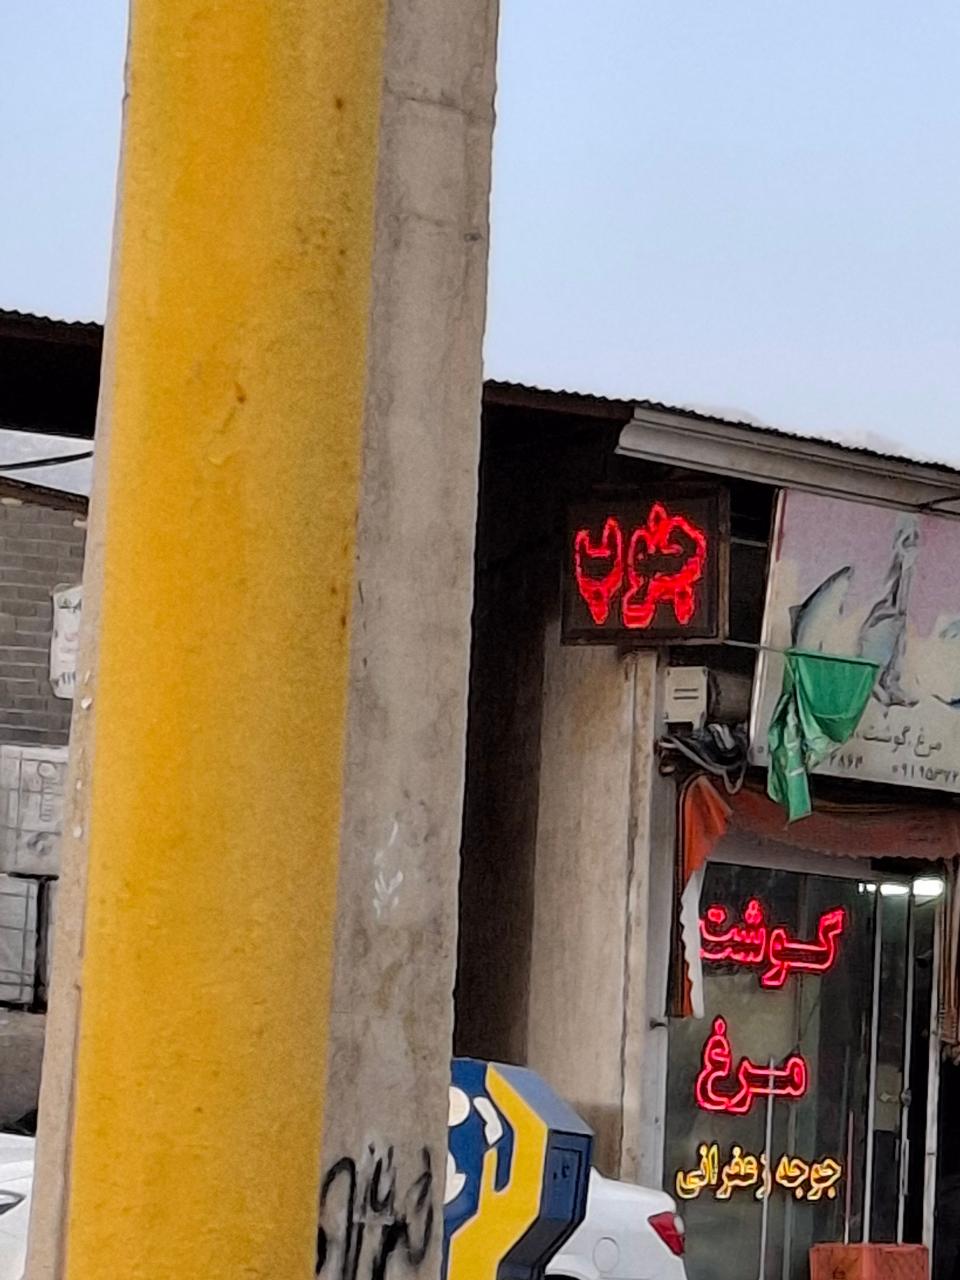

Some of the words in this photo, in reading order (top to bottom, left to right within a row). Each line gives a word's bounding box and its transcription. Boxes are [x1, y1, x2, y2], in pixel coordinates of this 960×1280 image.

[699, 897, 844, 986] گوشت
[696, 1018, 807, 1113] مرغ
[676, 1145, 771, 1200] زعفرانی
[776, 1154, 842, 1200] جوجه
